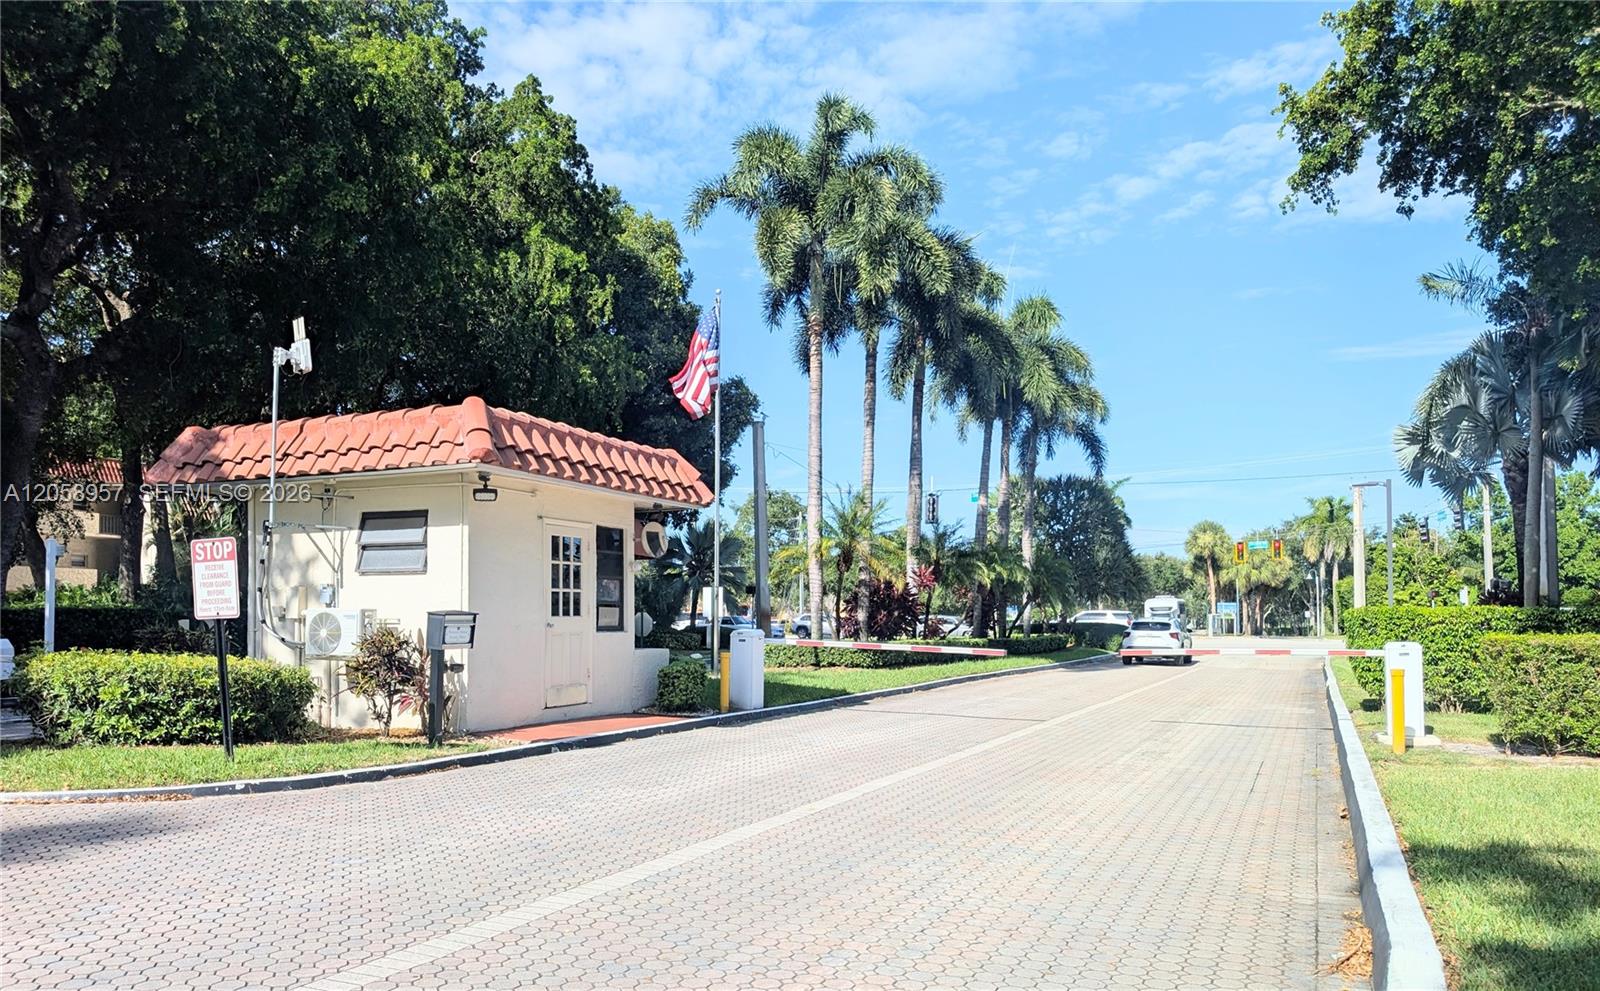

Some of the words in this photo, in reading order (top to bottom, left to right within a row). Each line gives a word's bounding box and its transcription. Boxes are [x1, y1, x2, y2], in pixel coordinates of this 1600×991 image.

[195, 540, 233, 561] STOP
[204, 563, 224, 571] RECEIVE
[201, 572, 229, 580] CLEARANCE
[200, 581, 214, 589] FROM
[214, 580, 232, 588] GUARD
[207, 589, 225, 597] BEFORE
[201, 598, 232, 606] PROCEEDING
